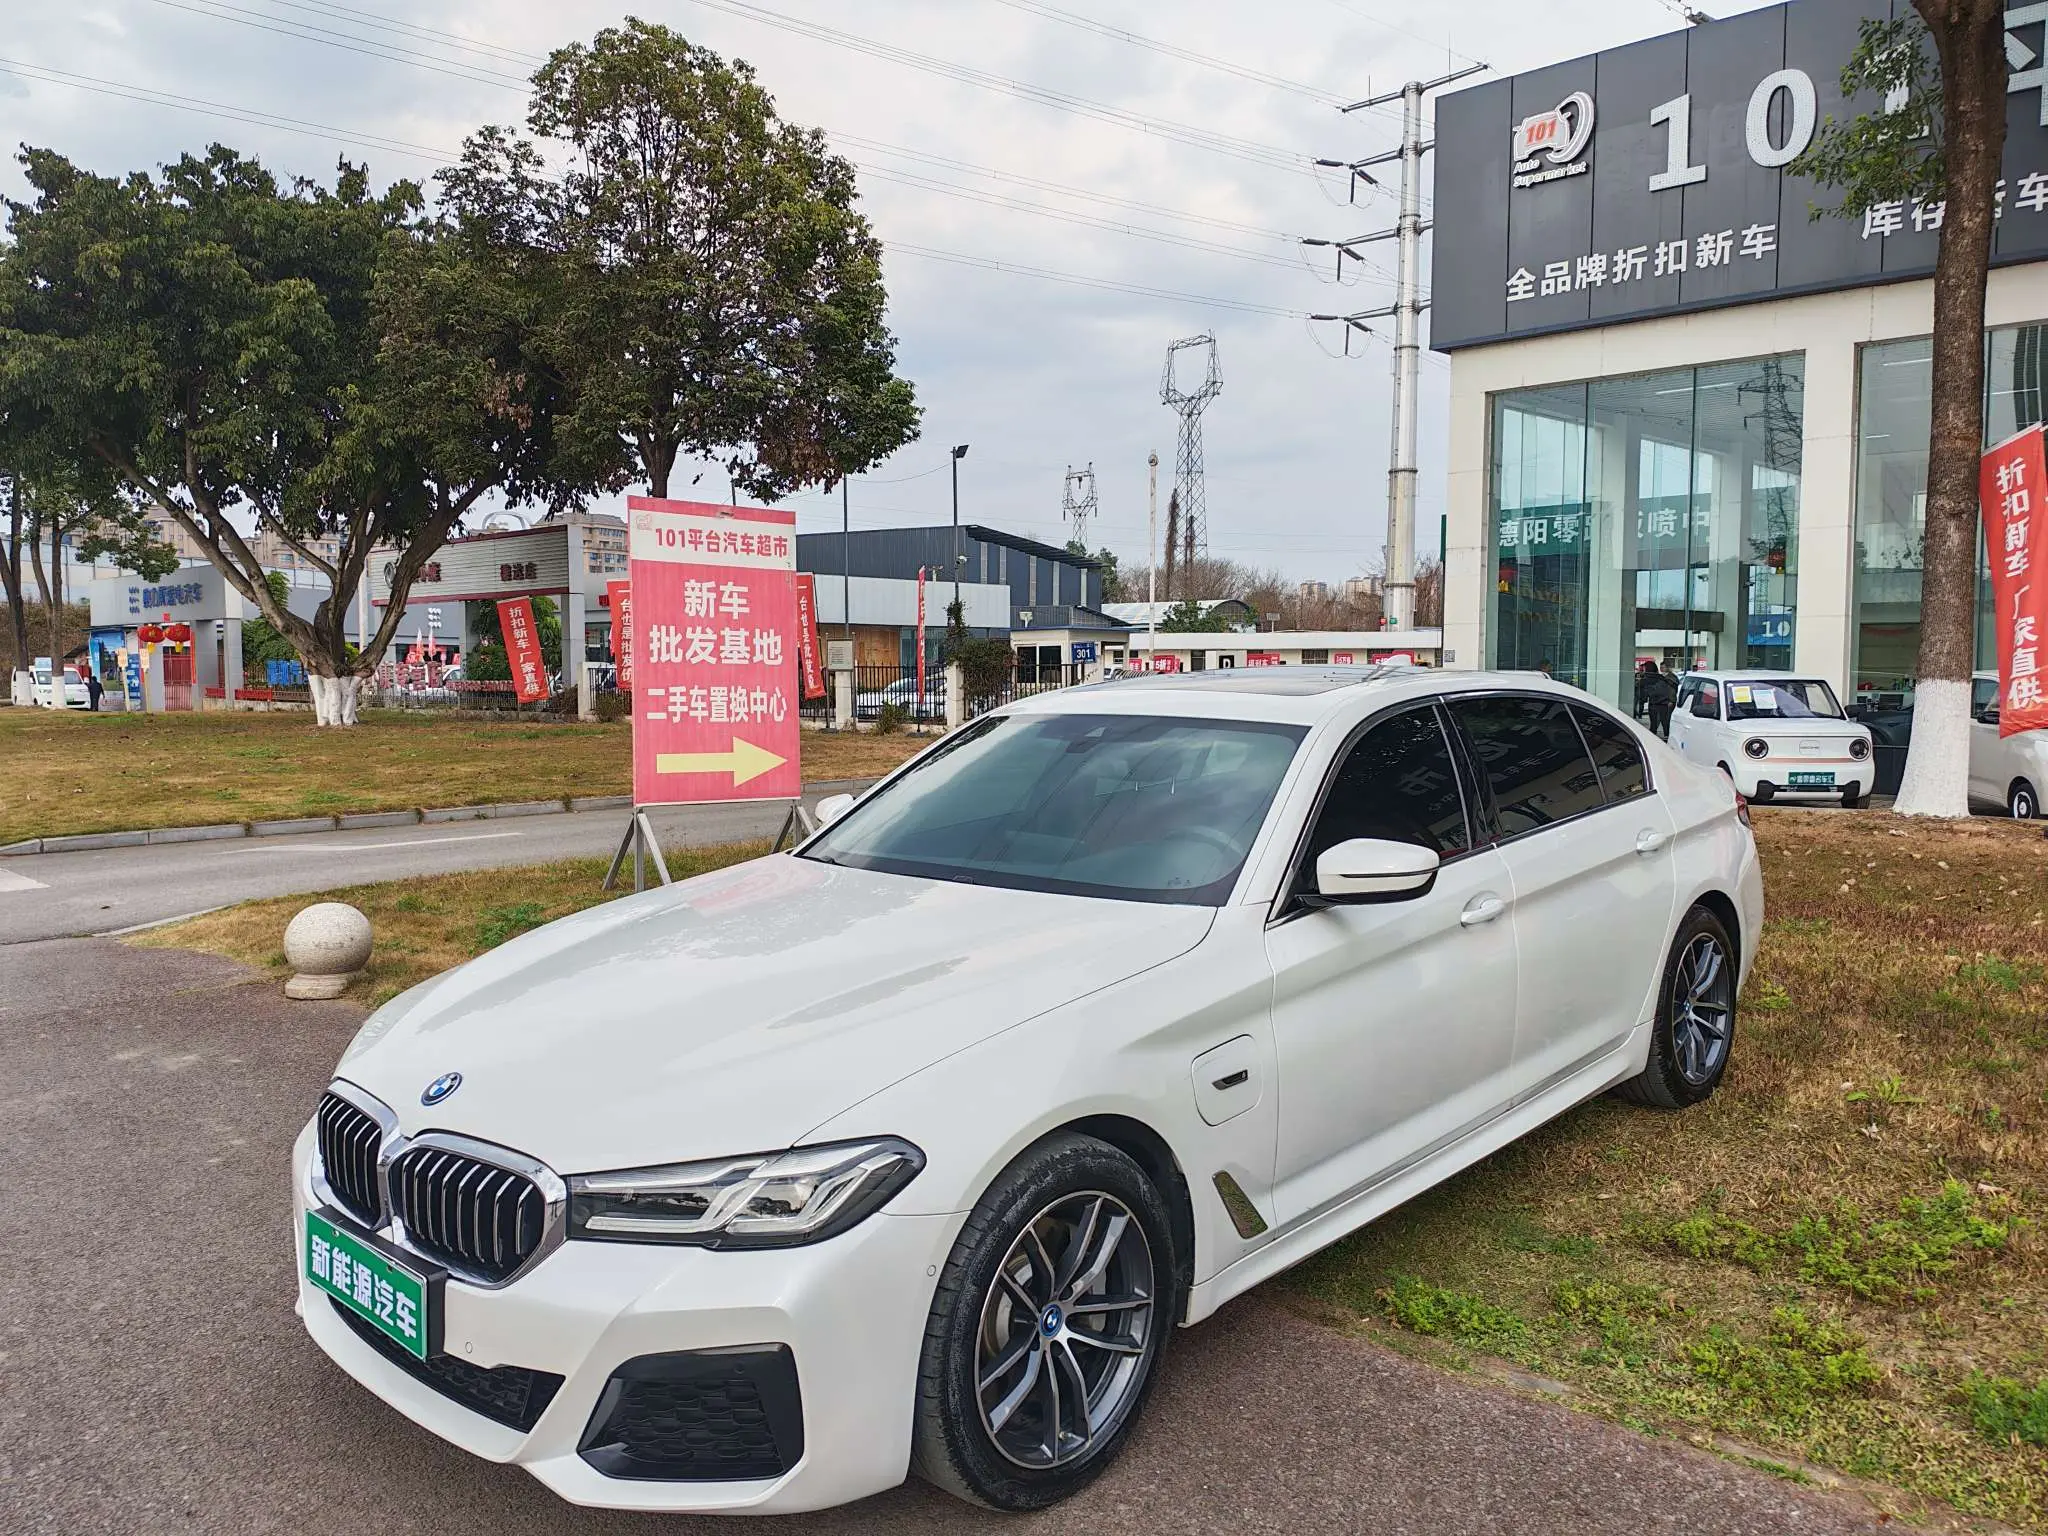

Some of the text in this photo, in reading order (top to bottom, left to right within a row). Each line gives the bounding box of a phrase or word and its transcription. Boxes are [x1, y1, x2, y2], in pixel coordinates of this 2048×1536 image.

[1526, 119, 1557, 145] 101
[1513, 160, 1540, 174] Auto
[1513, 162, 1586, 188] Supermarket
[1862, 172, 2048, 240] 库存车
[1506, 222, 1777, 303] 全品牌折扣新车
[655, 527, 788, 558] 101平台汽车超市
[683, 579, 751, 620] 新车
[1995, 456, 2042, 710] 折扣新车 厂家直供
[509, 606, 541, 695] 折扣新车 厂家直供
[649, 625, 784, 667] 批发基地
[1076, 648, 1090, 659] 301
[646, 685, 787, 726] 二手车置换中心
[311, 1234, 417, 1339] 新能源汽车
